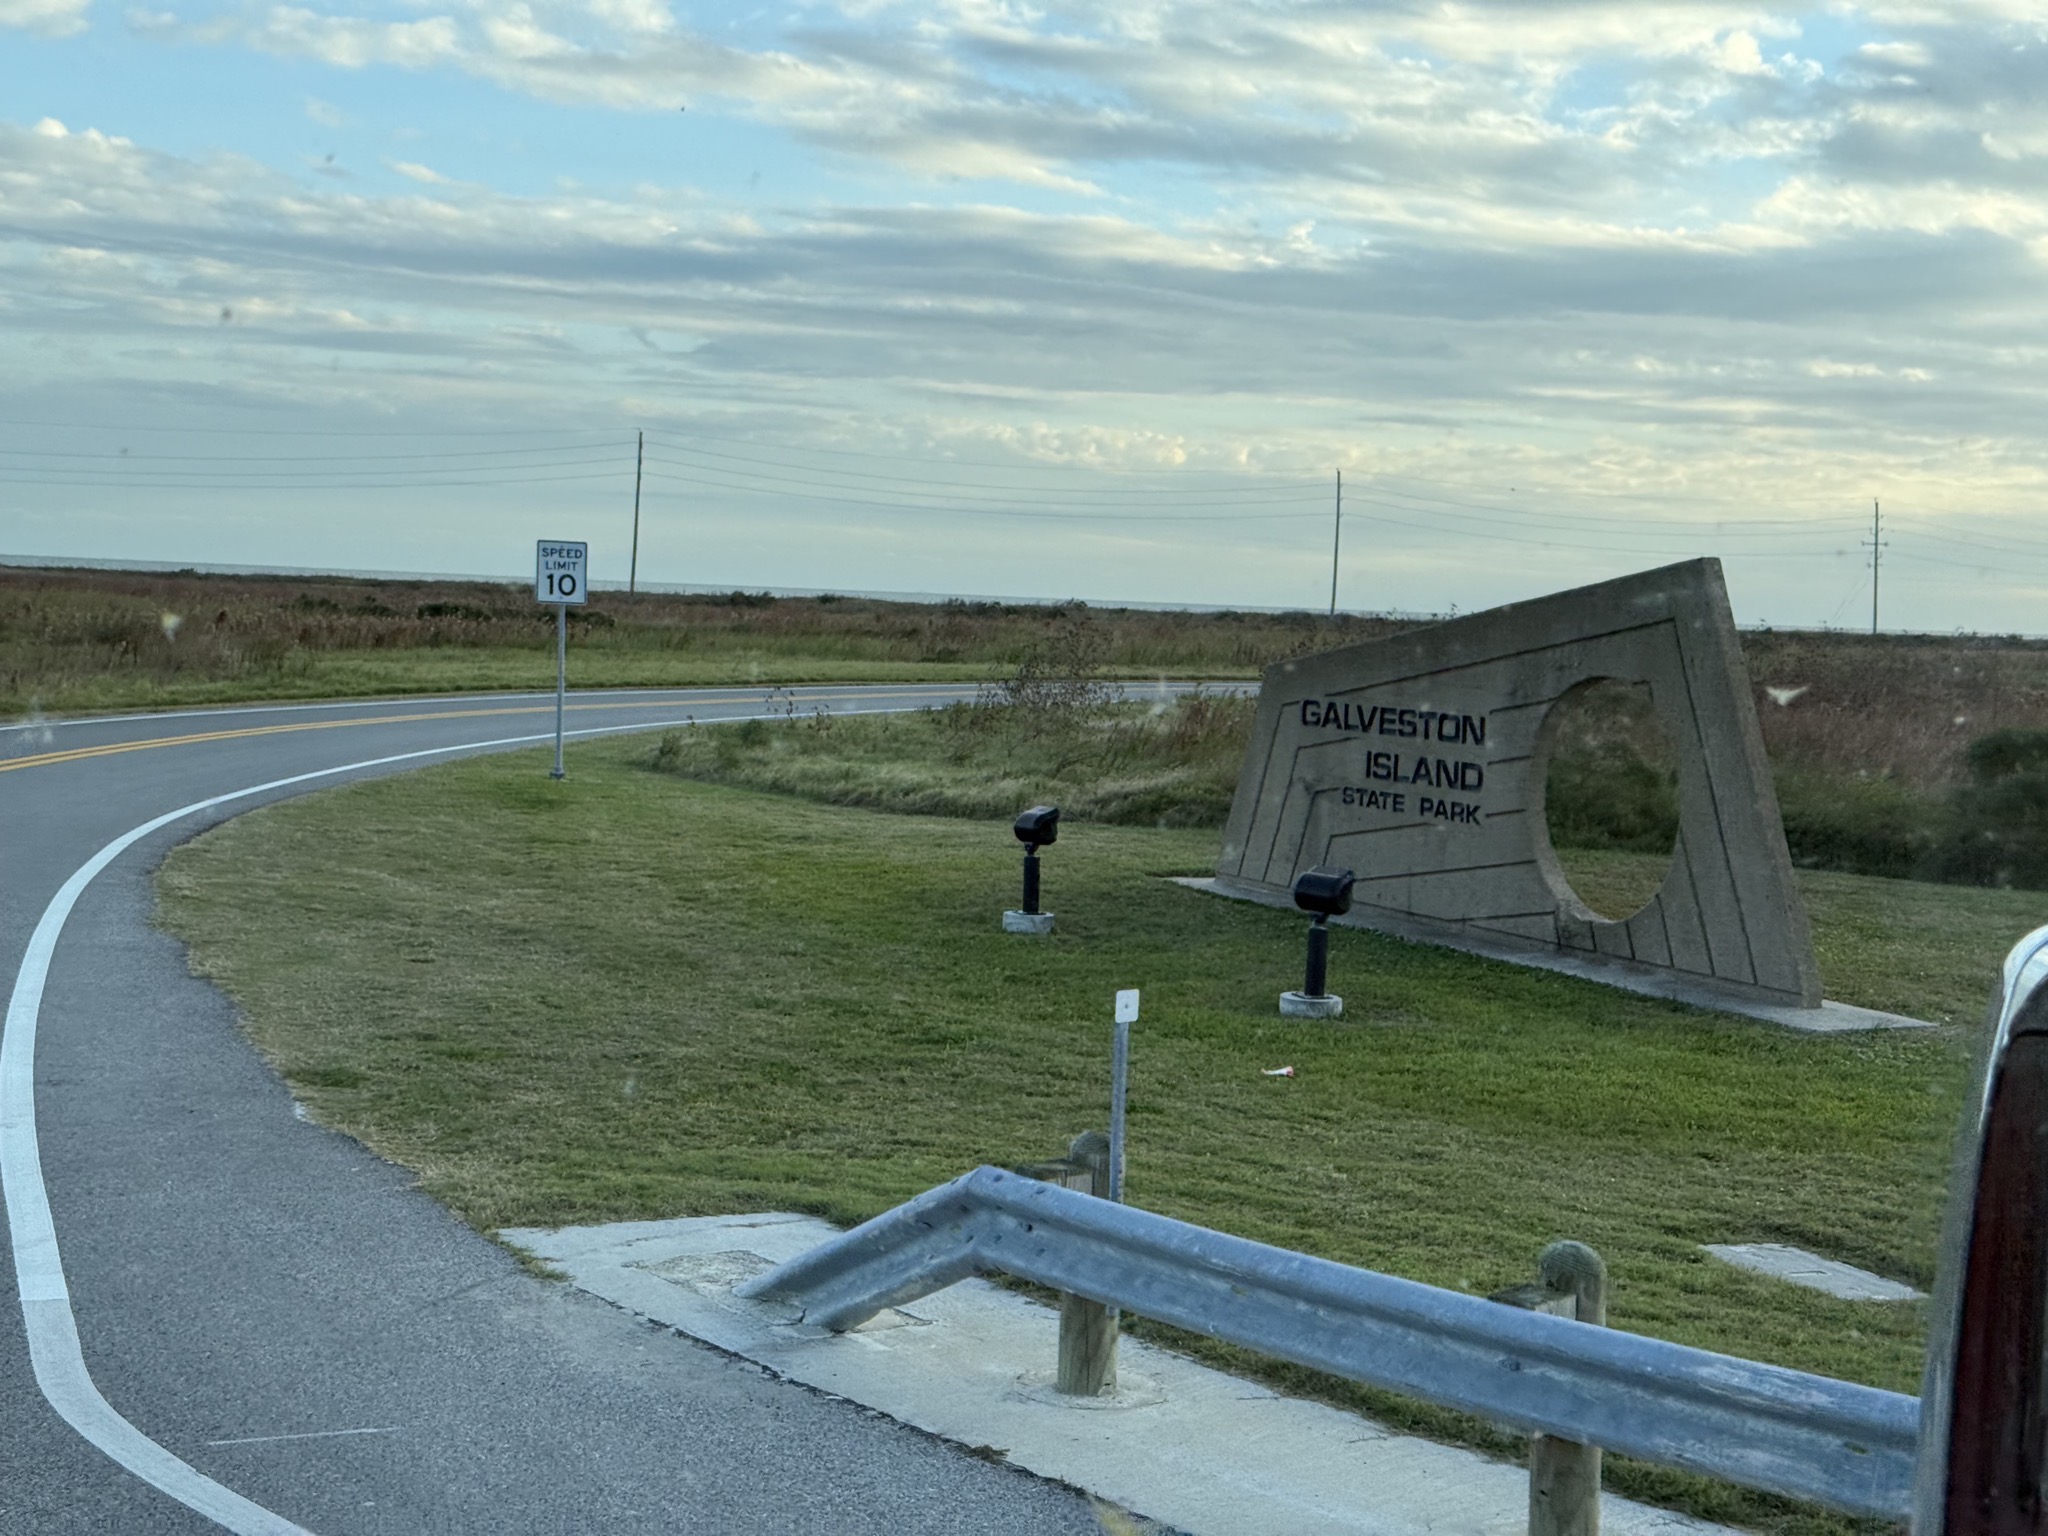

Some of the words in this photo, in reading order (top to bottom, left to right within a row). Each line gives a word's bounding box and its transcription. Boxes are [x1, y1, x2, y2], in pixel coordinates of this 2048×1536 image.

[542, 547, 583, 559] SPEED
[545, 560, 578, 571] LIMIT
[547, 573, 577, 596] 10
[1302, 699, 1486, 745] GALVESTON
[1365, 750, 1484, 792] ISLAND
[1342, 786, 1405, 813] STATE
[1420, 797, 1481, 825] PARK
